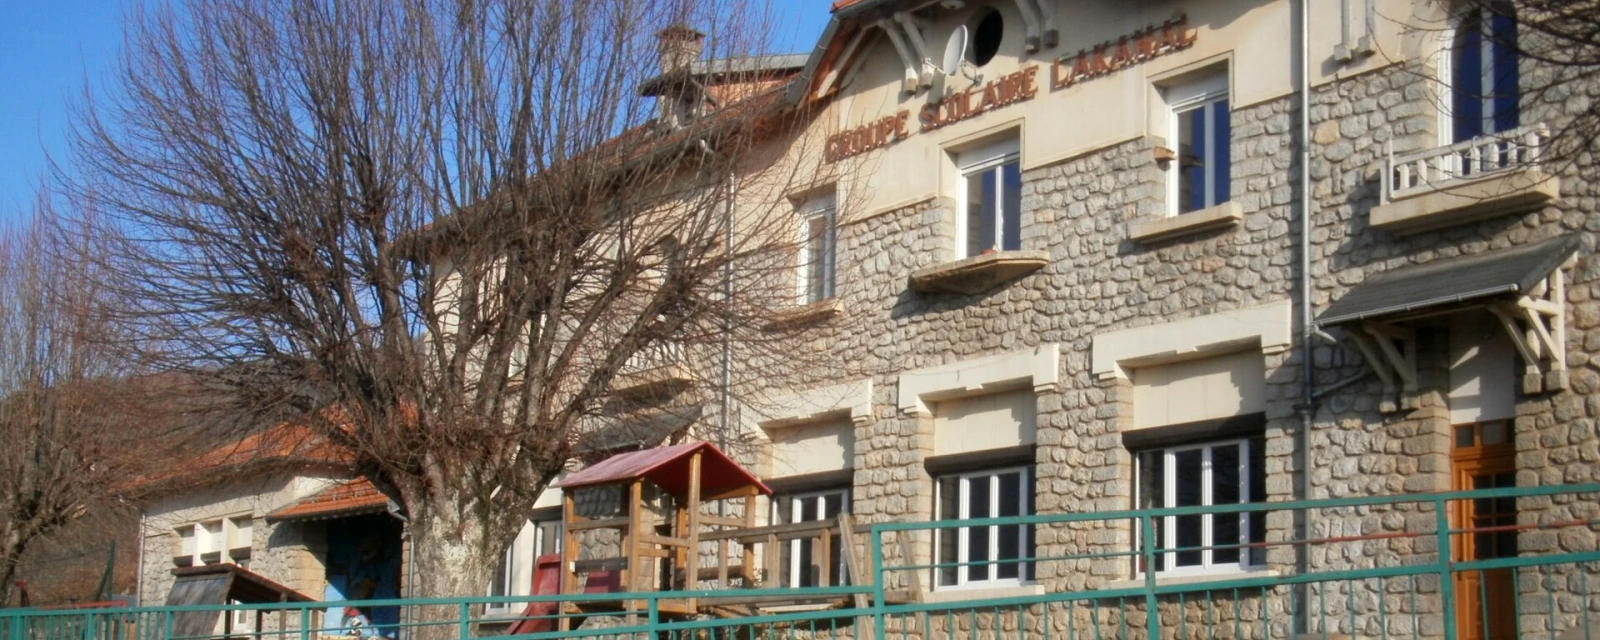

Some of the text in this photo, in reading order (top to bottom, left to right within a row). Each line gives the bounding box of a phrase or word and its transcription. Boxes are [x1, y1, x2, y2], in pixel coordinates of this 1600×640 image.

[825, 14, 1198, 163] GROUPE SCOLAIRE LAKANAL
